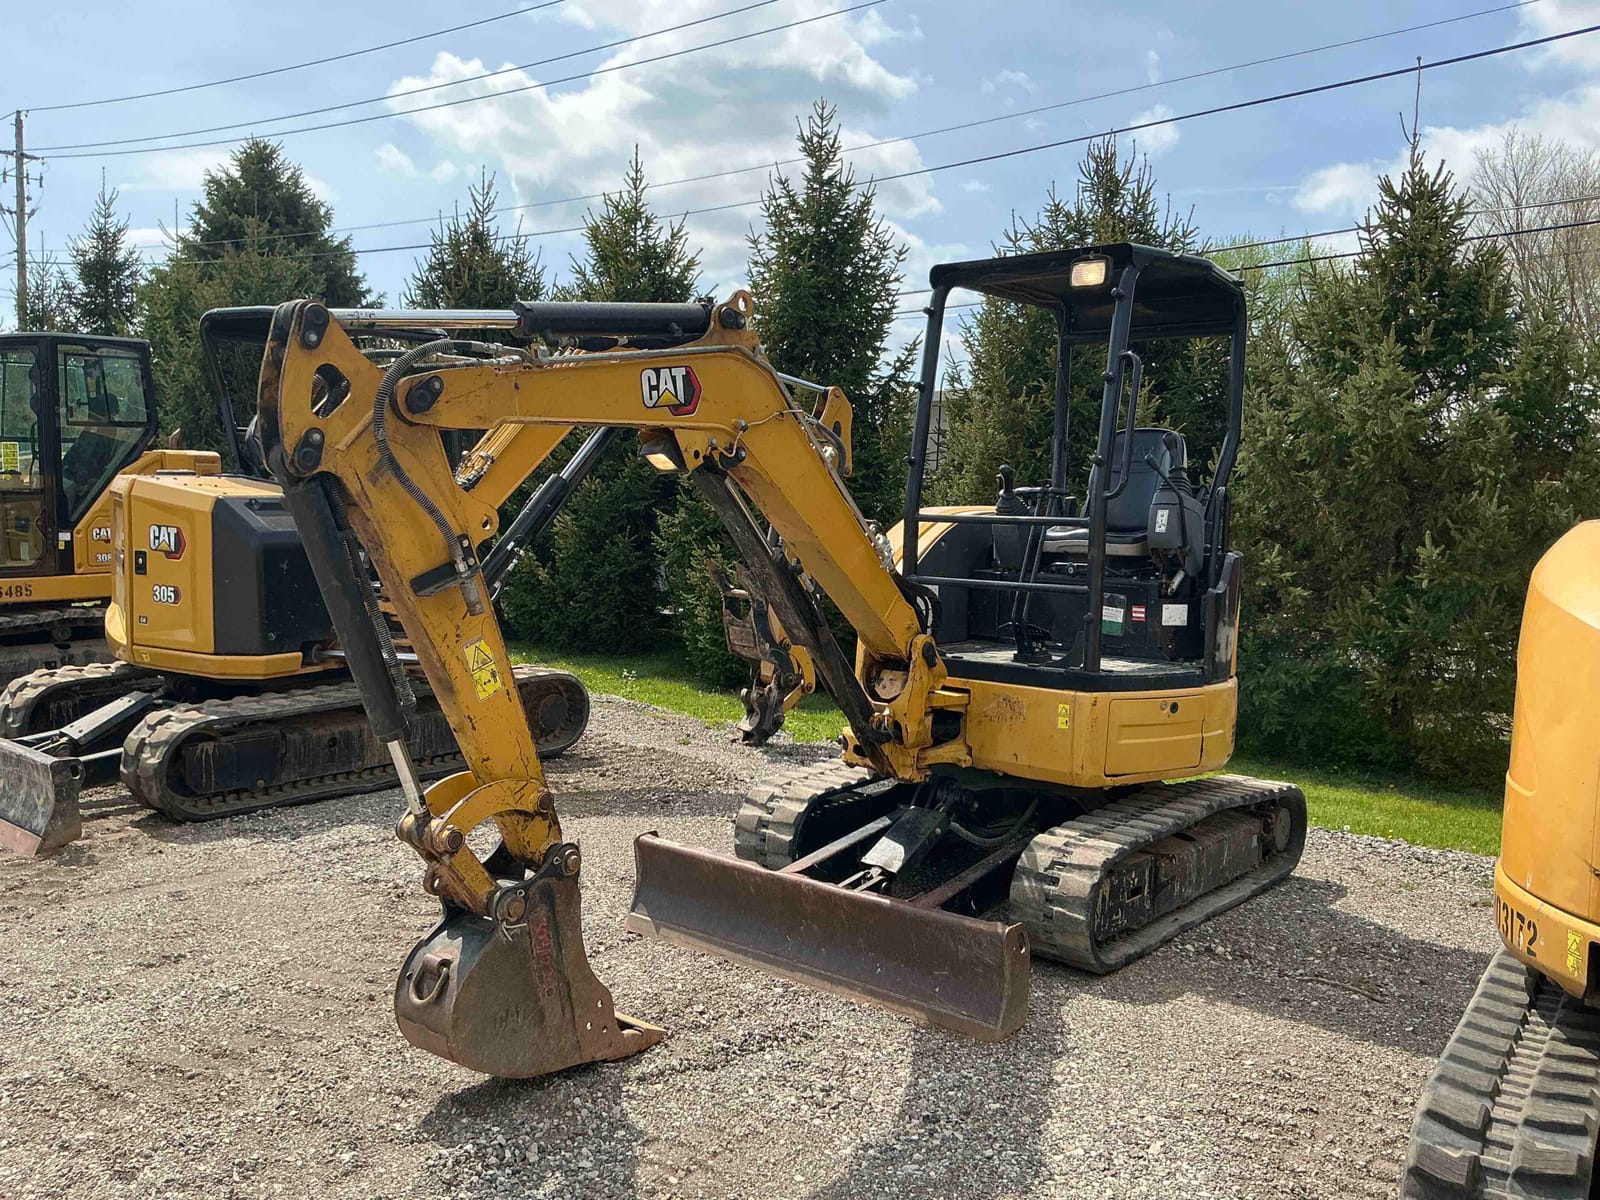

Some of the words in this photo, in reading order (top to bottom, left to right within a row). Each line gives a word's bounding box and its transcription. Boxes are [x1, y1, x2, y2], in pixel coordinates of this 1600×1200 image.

[641, 367, 687, 407] CAT
[92, 528, 112, 540] CAT
[150, 525, 177, 552] CAT
[153, 585, 175, 603] 305
